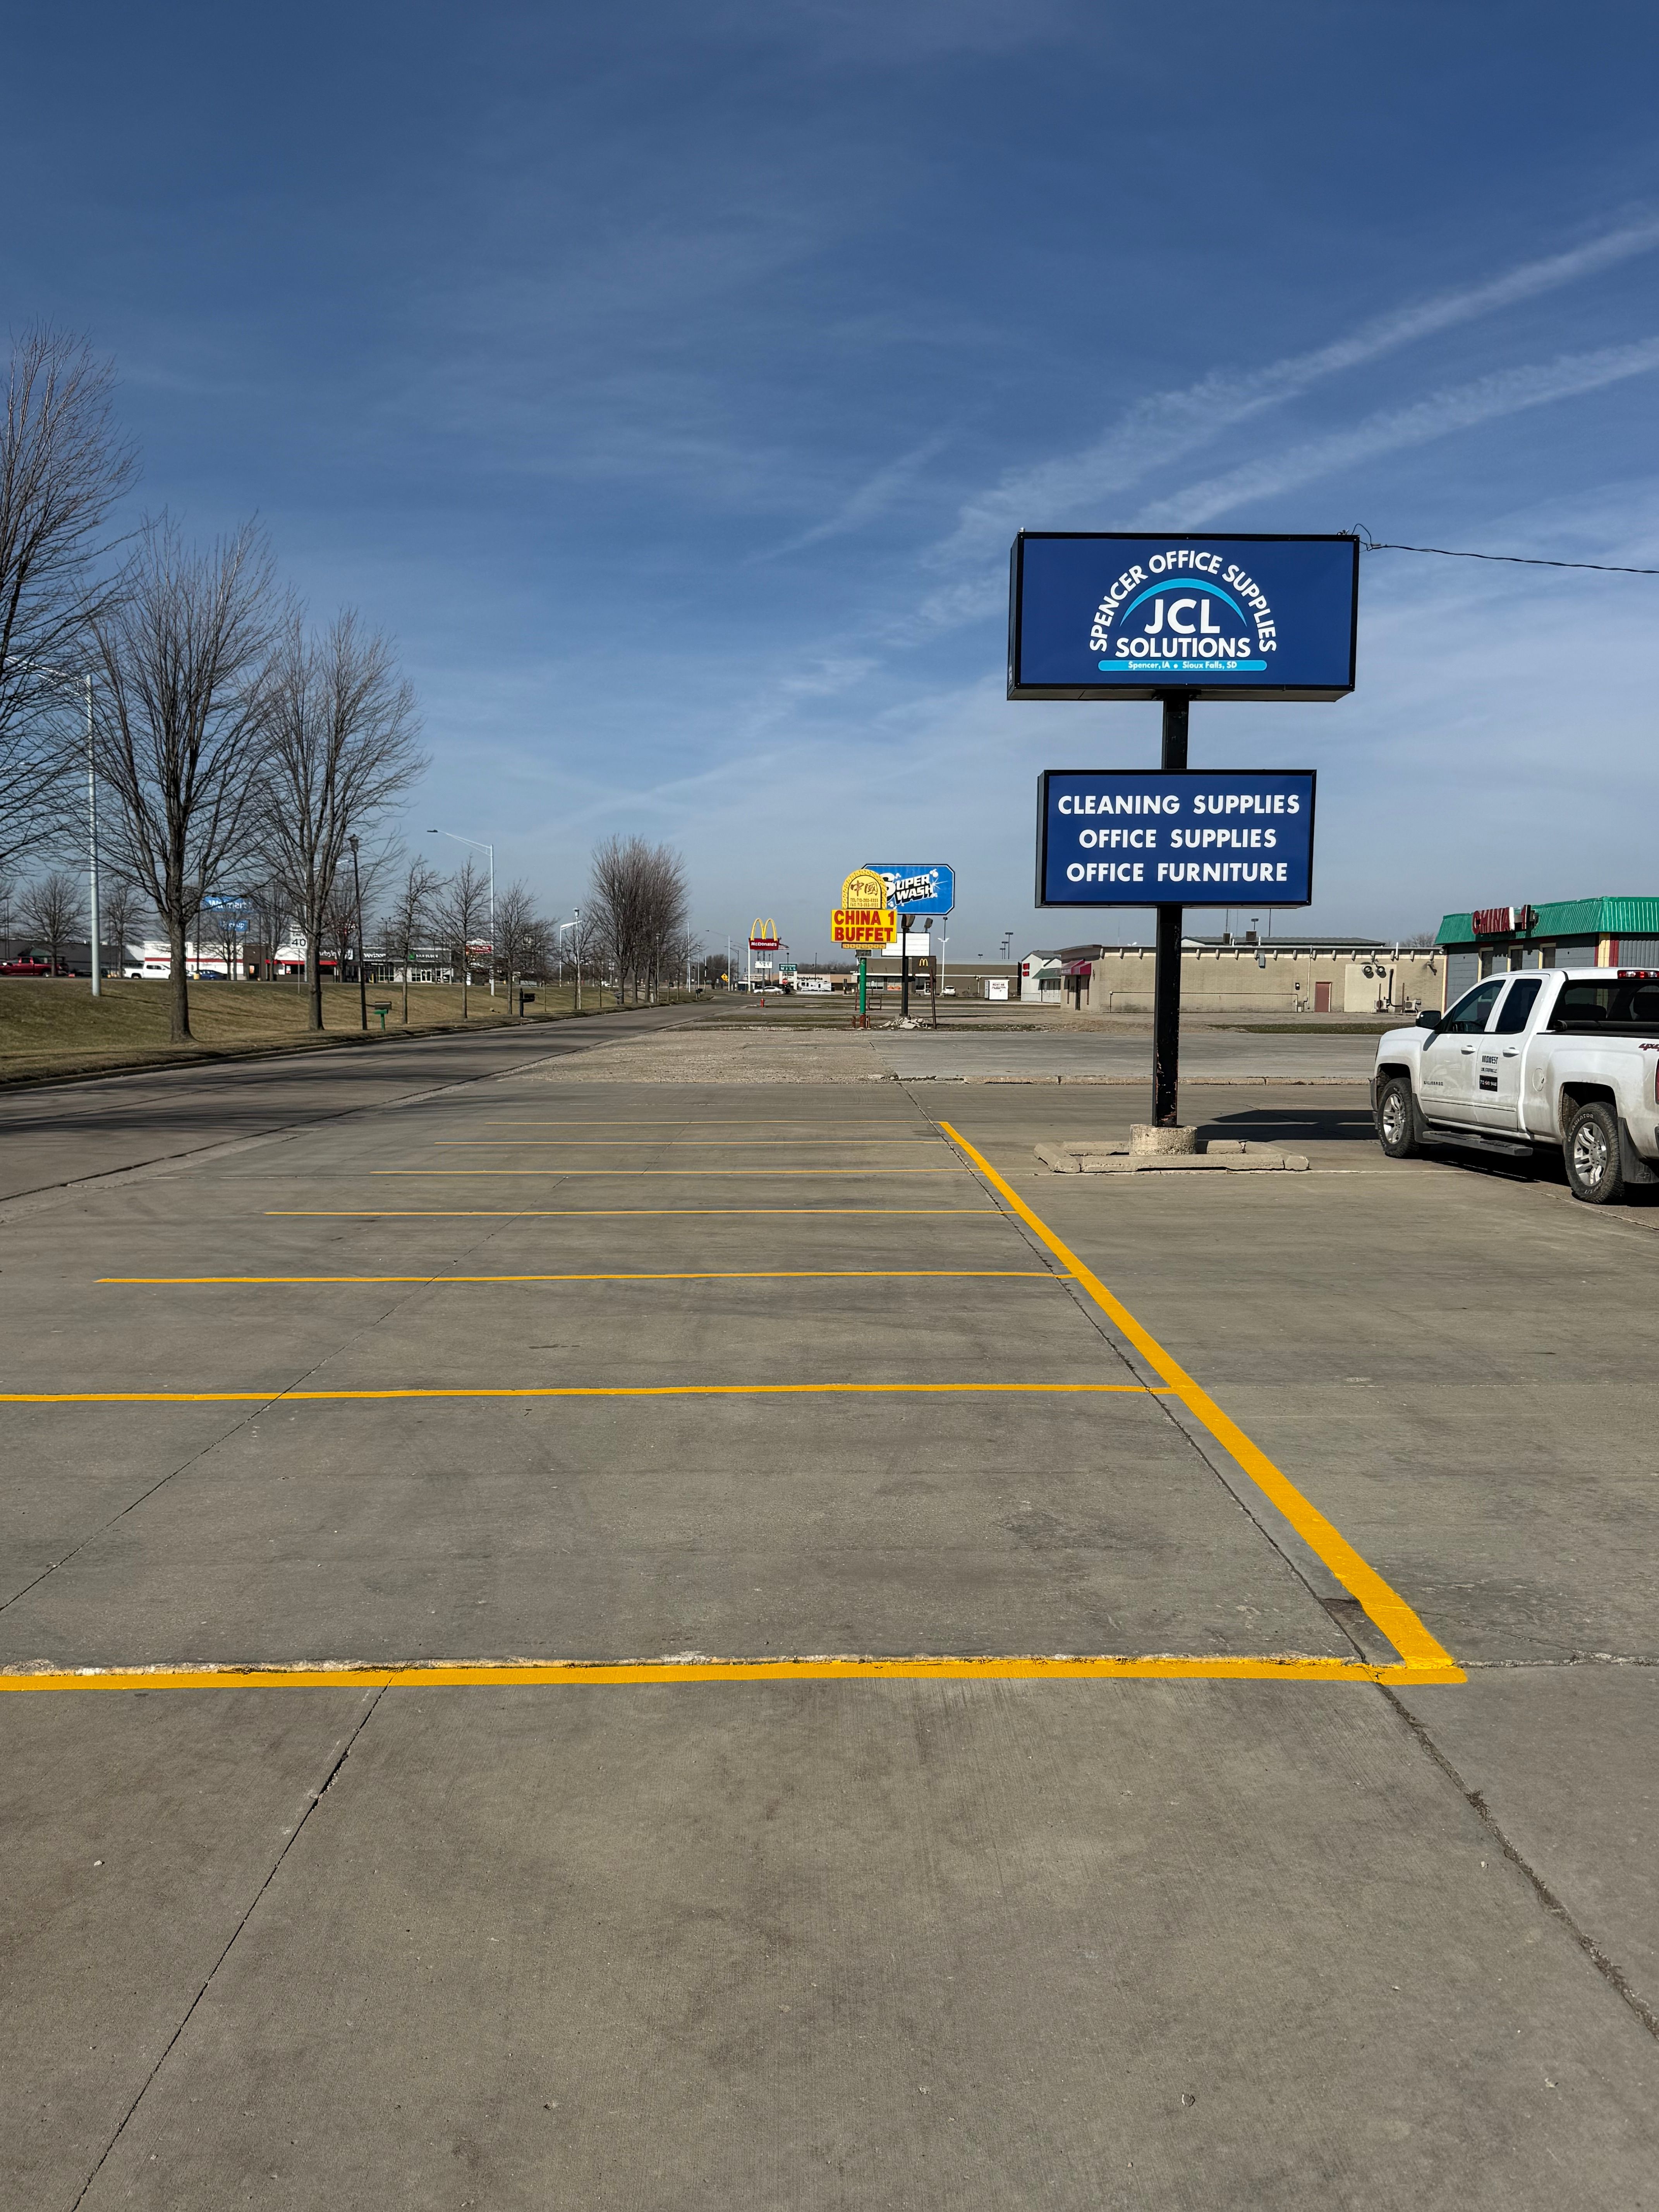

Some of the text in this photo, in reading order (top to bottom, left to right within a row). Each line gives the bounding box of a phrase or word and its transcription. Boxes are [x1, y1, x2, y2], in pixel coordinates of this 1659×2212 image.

[1090, 550, 1277, 652] SPENCER OFFICE SUPPLIES
[1144, 599, 1220, 634] JCL
[1115, 637, 1251, 658] SOLUTIONS
[1128, 661, 1161, 670] Spencer,
[1182, 661, 1237, 670] Sioux Falls, SD
[1058, 795, 1300, 814] CLEANING SUPPLIES
[1079, 829, 1276, 848] OFFICE SUPPLIES
[1066, 863, 1287, 882] OFFICE FURNITURE
[850, 880, 878, 896] 中國
[880, 873, 930, 898] SUPER
[896, 884, 934, 901] WASH
[834, 910, 894, 925] CHINA 1
[1472, 904, 1531, 935] CHINA 1
[835, 927, 893, 942] BUFFET
[1638, 1043, 1659, 1051] 4x4
